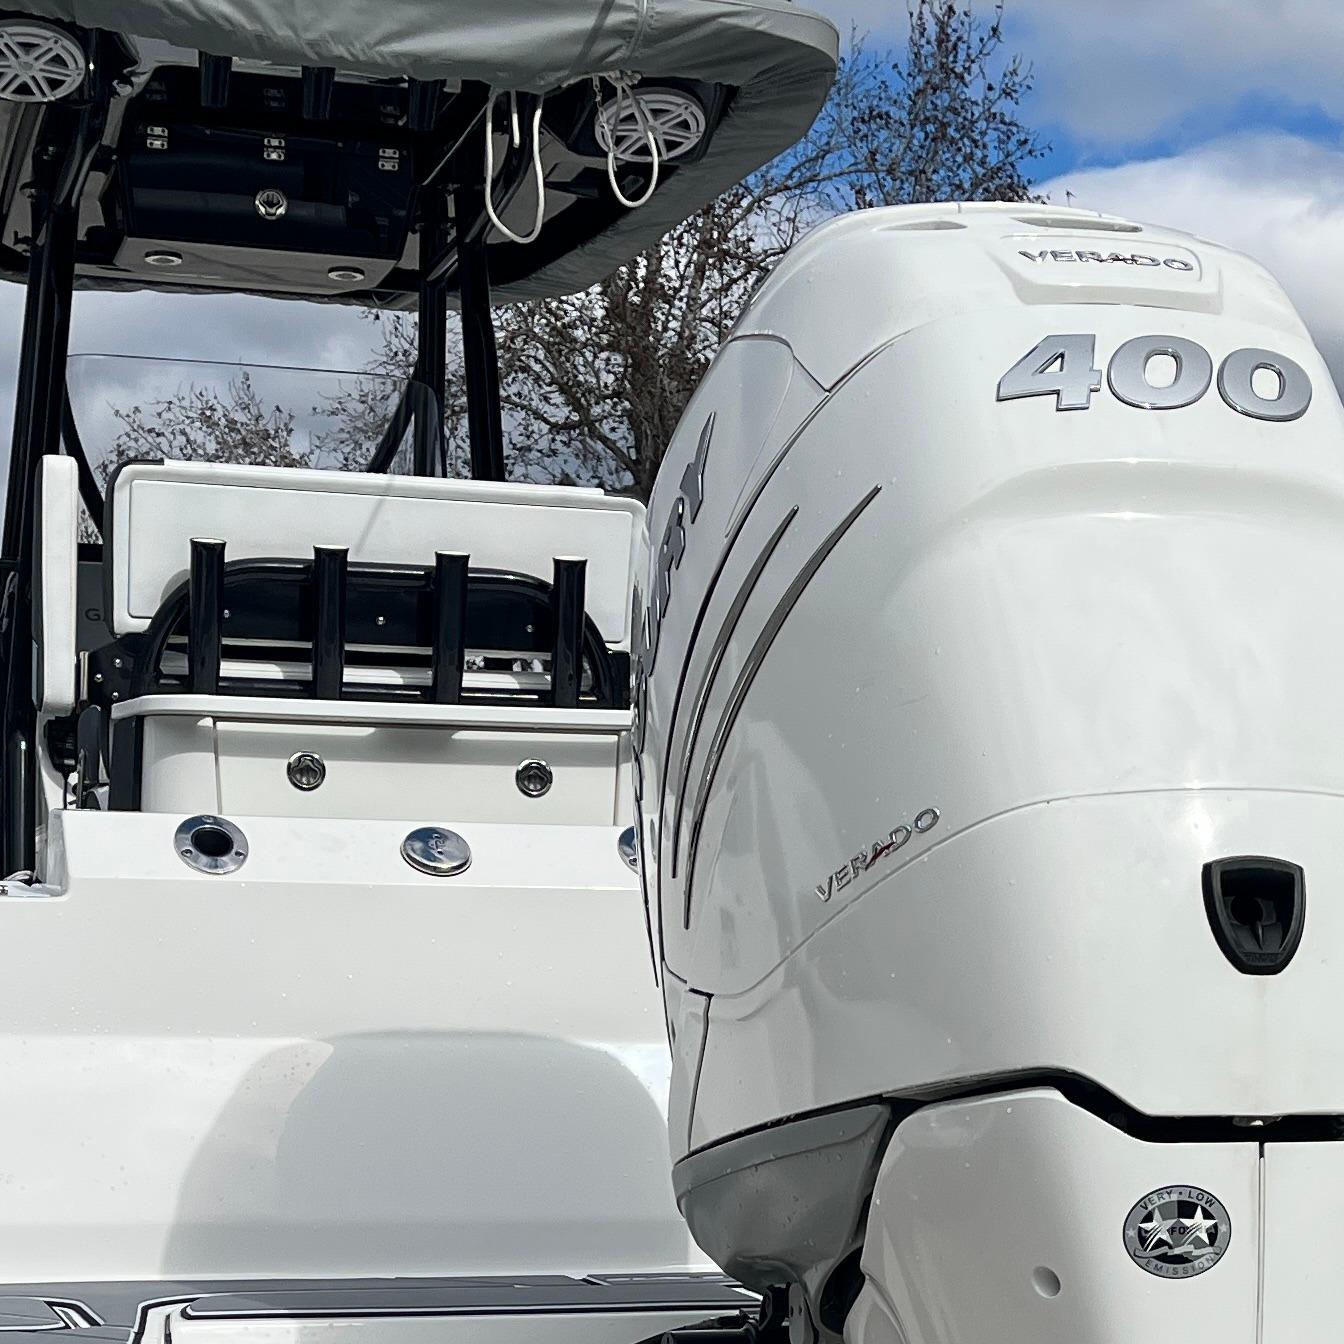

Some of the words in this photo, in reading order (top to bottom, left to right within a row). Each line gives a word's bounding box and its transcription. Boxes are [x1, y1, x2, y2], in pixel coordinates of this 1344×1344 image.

[1018, 249, 1194, 272] VERADO
[997, 333, 1313, 422] 400
[815, 807, 941, 902] VERADO
[1140, 1189, 1173, 1212] VERY
[1187, 1189, 1216, 1208] LOW
